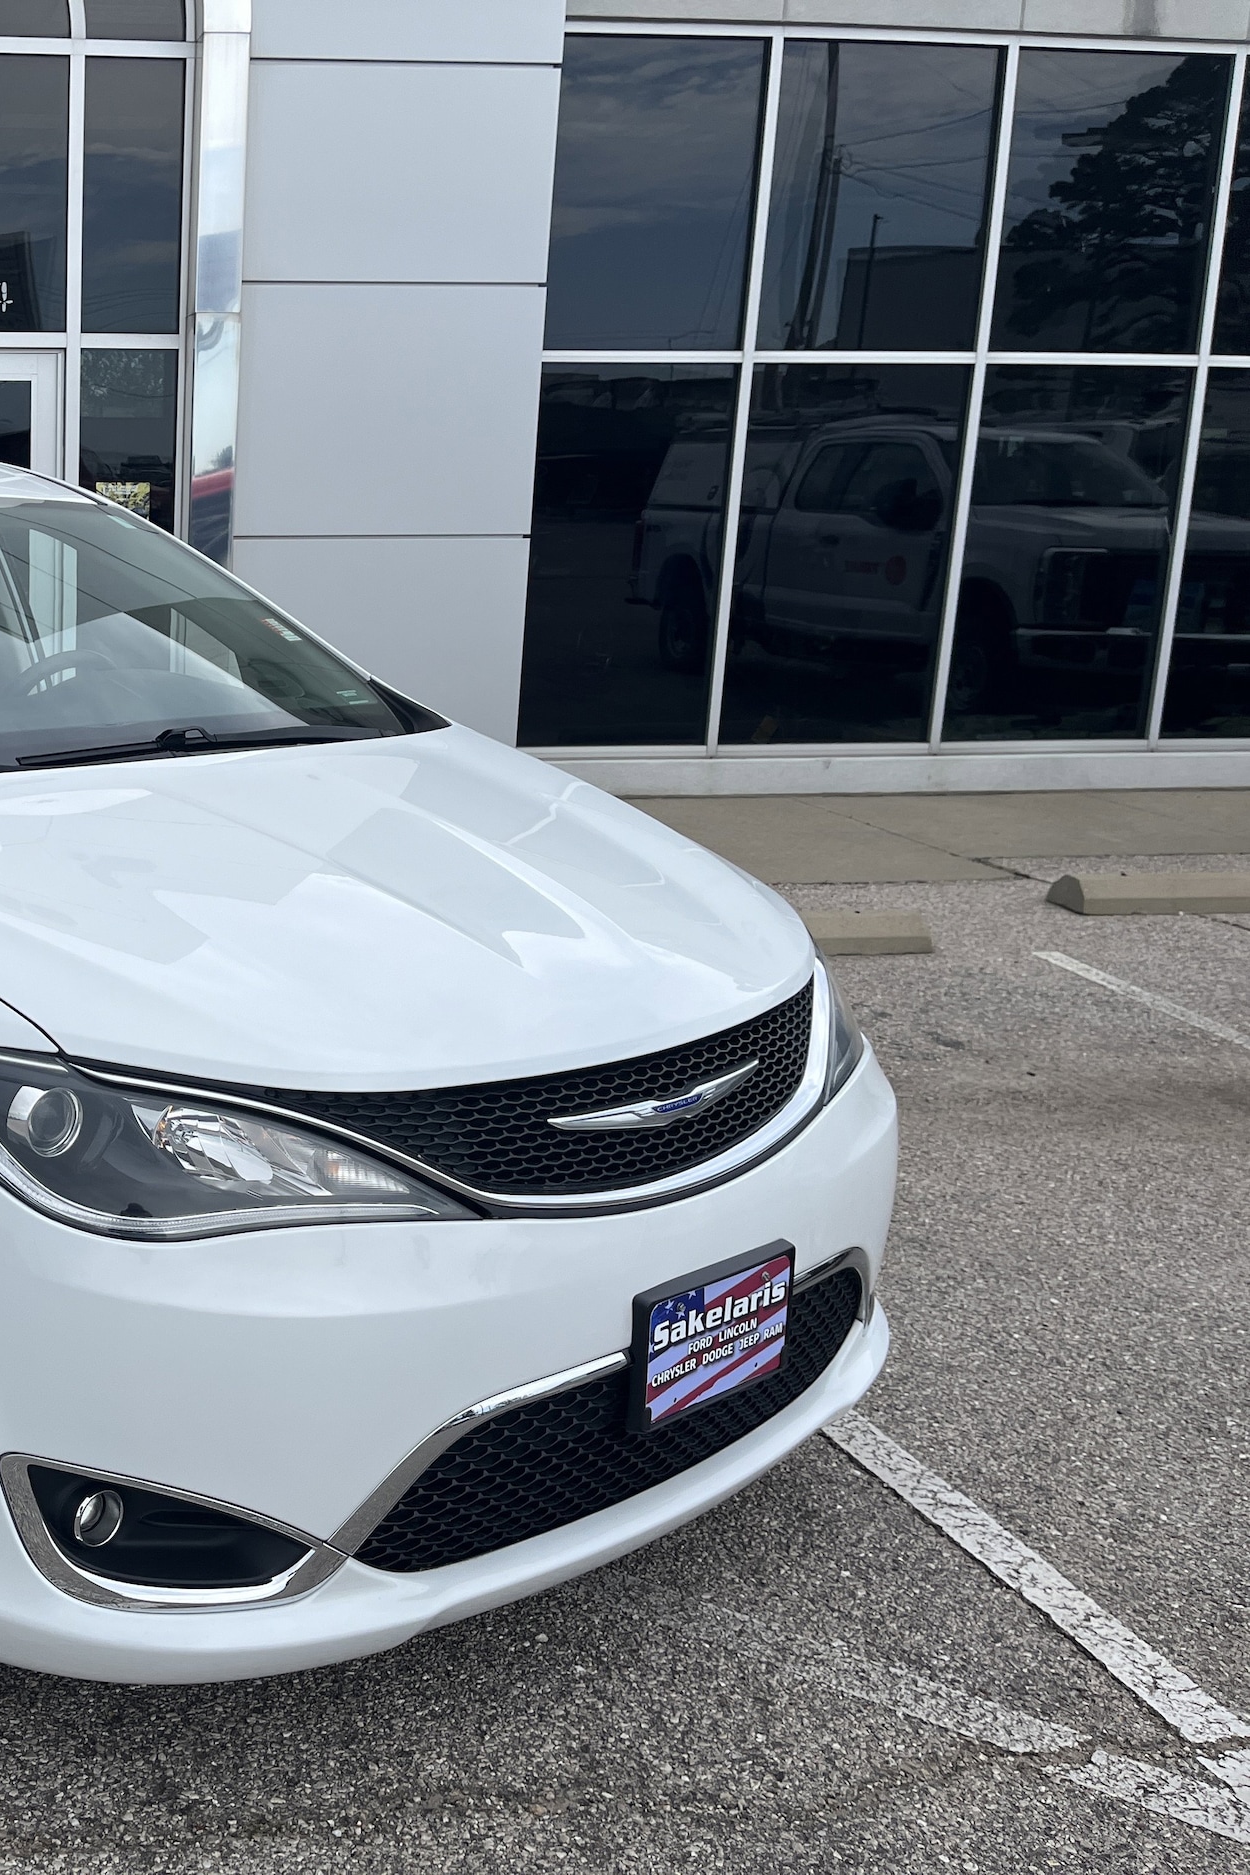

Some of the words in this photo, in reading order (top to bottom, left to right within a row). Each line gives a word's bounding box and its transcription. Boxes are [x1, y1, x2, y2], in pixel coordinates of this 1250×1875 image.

[656, 1096, 698, 1111] CHRYSLER
[653, 1281, 786, 1351] Sakelaris
[688, 1336, 713, 1355] FORD
[718, 1318, 758, 1342] LINCOLN
[651, 1358, 697, 1388] CHRYSLER
[702, 1344, 734, 1365] DODGE
[738, 1332, 760, 1351] JEEP
[763, 1322, 784, 1341] RAM
